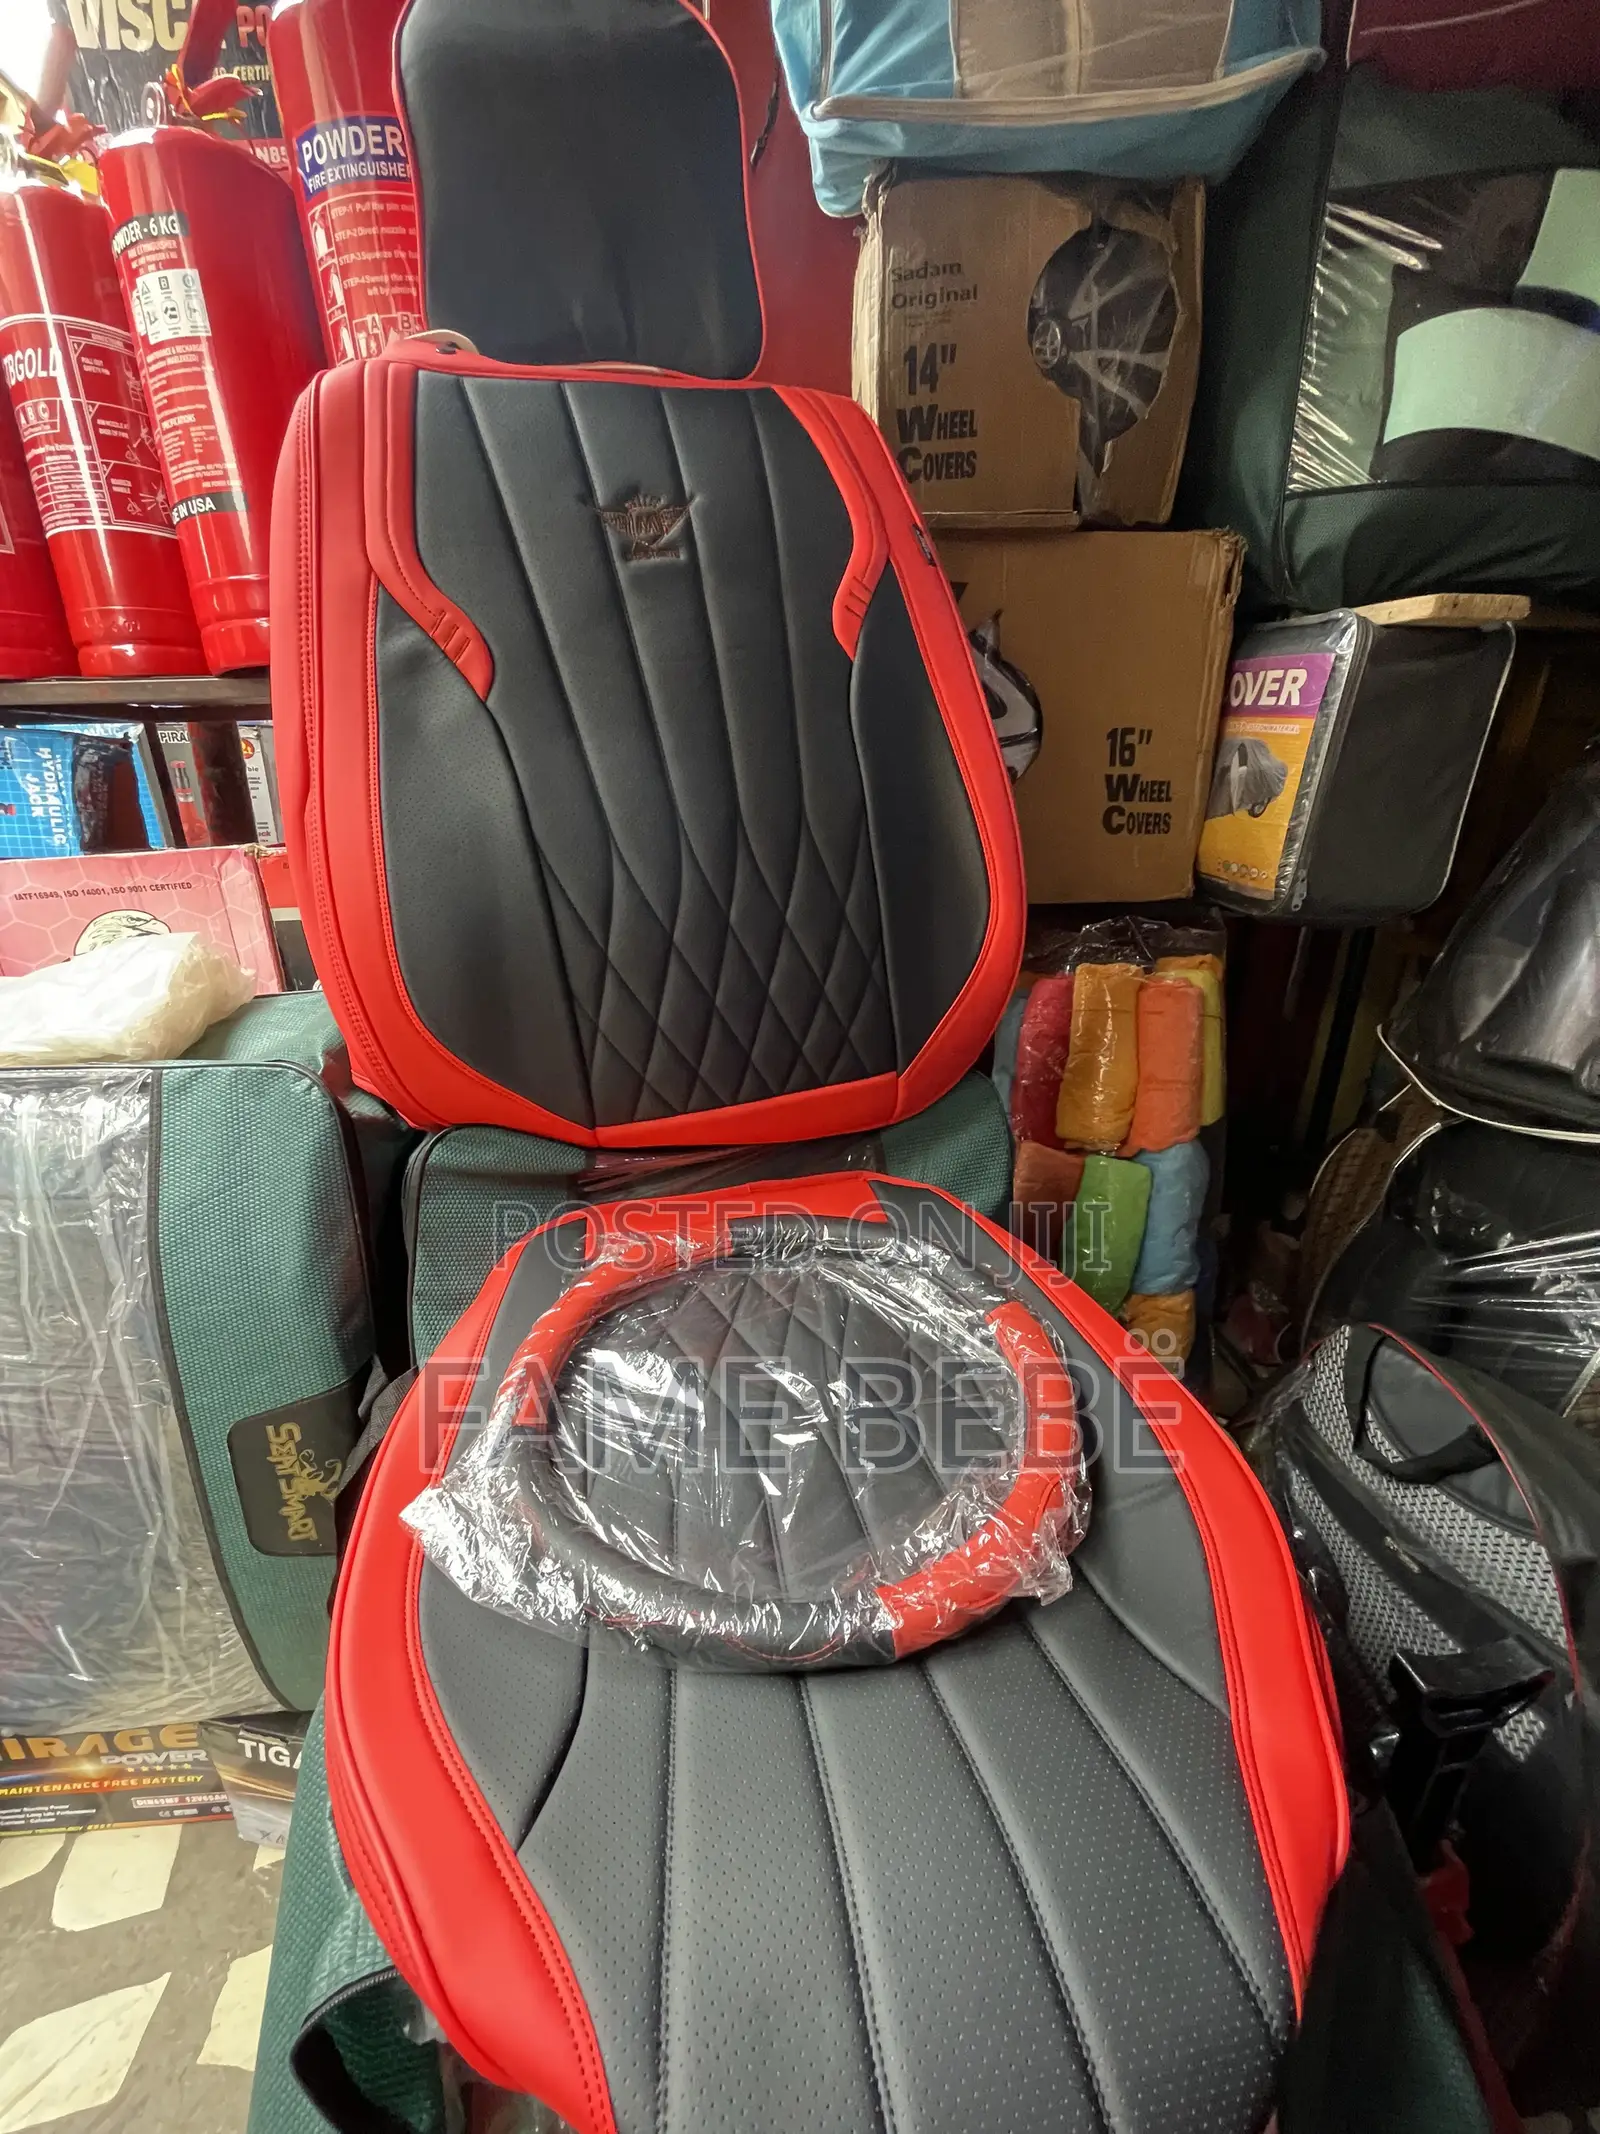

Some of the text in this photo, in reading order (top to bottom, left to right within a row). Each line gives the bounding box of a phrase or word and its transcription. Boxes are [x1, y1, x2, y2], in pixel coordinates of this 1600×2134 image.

[302, 124, 407, 172] POWDER
[308, 172, 328, 194] FIRE
[149, 217, 158, 236] 6
[159, 214, 181, 236] KG
[892, 260, 962, 282] Sadam
[892, 283, 977, 309] Original
[904, 342, 957, 396] 14"
[896, 403, 977, 444] WHEEL
[188, 496, 216, 515] USA
[1230, 668, 1308, 708] OVER
[158, 730, 190, 743] PIRA
[1106, 726, 1153, 768] 16"
[25, 772, 45, 818] JACK
[35, 747, 67, 845] HYDRAULIC
[1105, 773, 1172, 803] WHEEL
[1102, 804, 1172, 836] COVERS
[14, 881, 192, 901] IATF16949, ISO 14001, ISO 9001 CERTIFIED
[0, 1723, 200, 1761] IRAGE
[100, 1748, 208, 1766] POWER
[0, 1774, 204, 1796] MAINTENANCE FREE BATTERY
